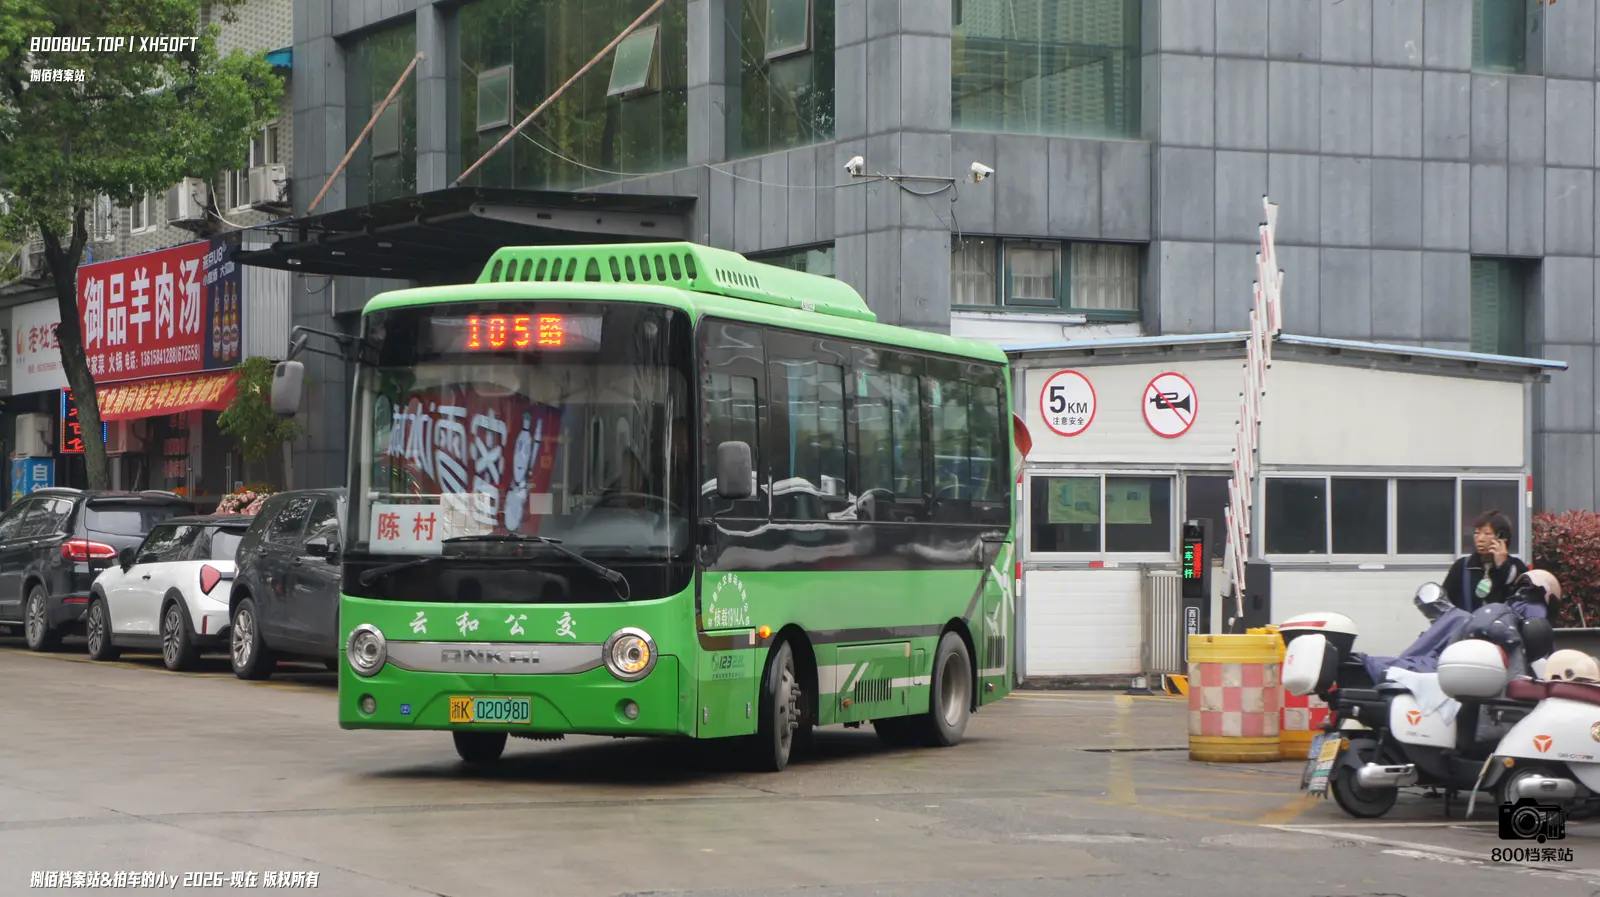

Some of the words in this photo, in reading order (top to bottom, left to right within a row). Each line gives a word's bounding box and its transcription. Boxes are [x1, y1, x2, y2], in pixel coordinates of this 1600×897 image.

[84, 258, 200, 349] 御品羊肉汤
[1052, 416, 1084, 426] 注意安全
[377, 512, 437, 541] 陈村
[409, 611, 577, 639] 云和公交
[441, 649, 539, 664] ANKAI
